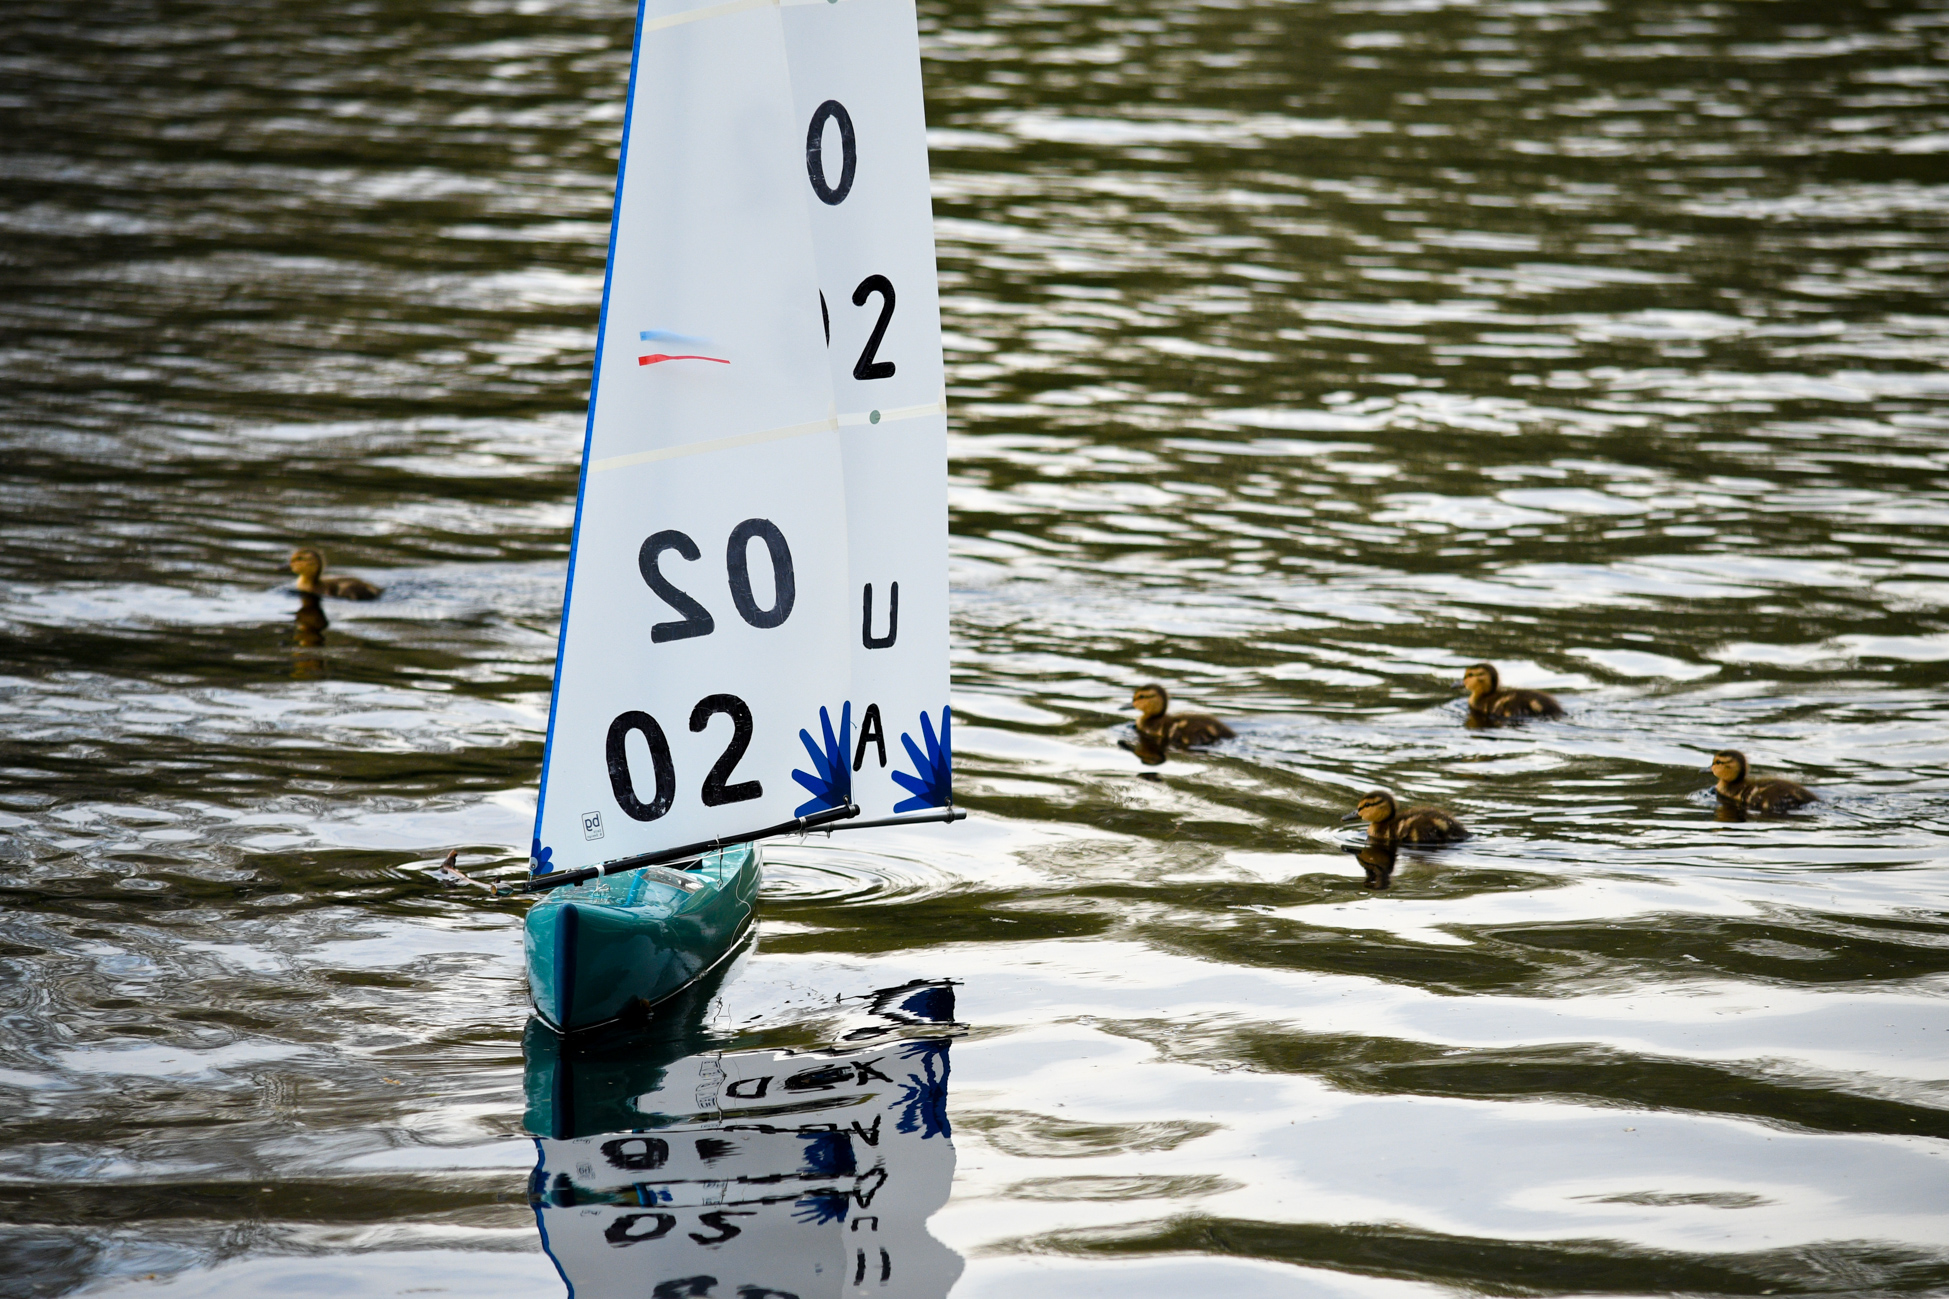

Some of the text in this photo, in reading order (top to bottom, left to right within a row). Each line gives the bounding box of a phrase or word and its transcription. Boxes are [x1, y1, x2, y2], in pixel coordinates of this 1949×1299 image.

[862, 581, 899, 650] U
[605, 693, 763, 822] 02
[852, 703, 888, 772] A
